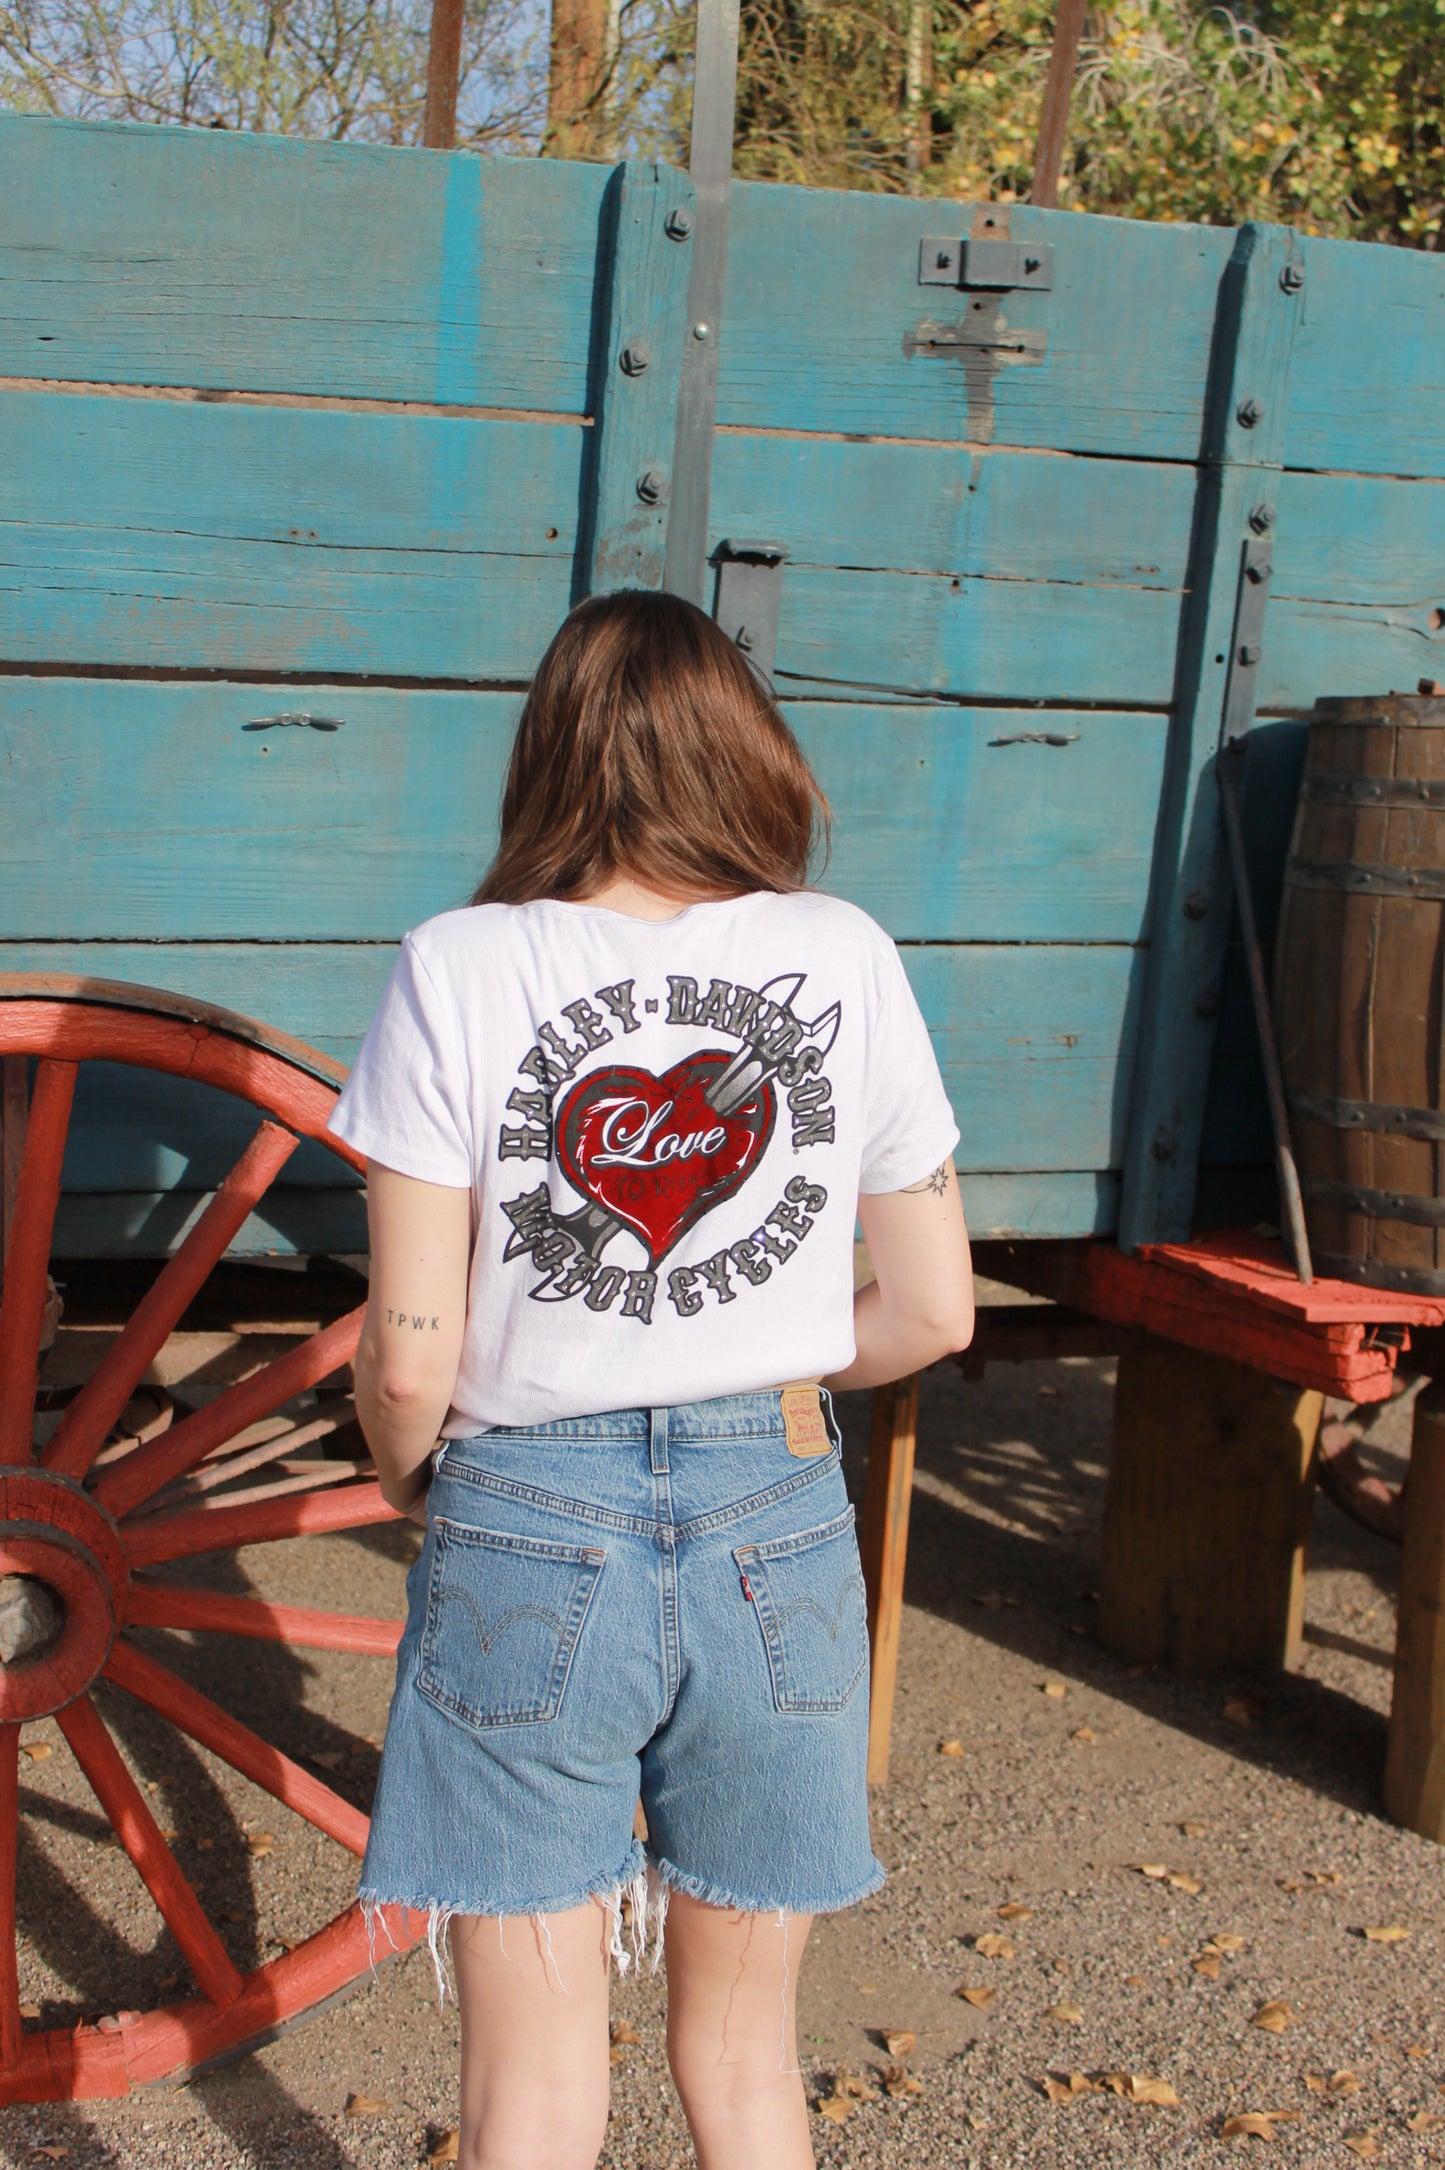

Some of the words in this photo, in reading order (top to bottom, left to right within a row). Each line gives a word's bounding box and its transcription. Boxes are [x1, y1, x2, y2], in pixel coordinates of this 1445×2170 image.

[590, 1099, 728, 1166] Love
[667, 1175, 828, 1317] CYCLES
[387, 1308, 440, 1331] TPWK
